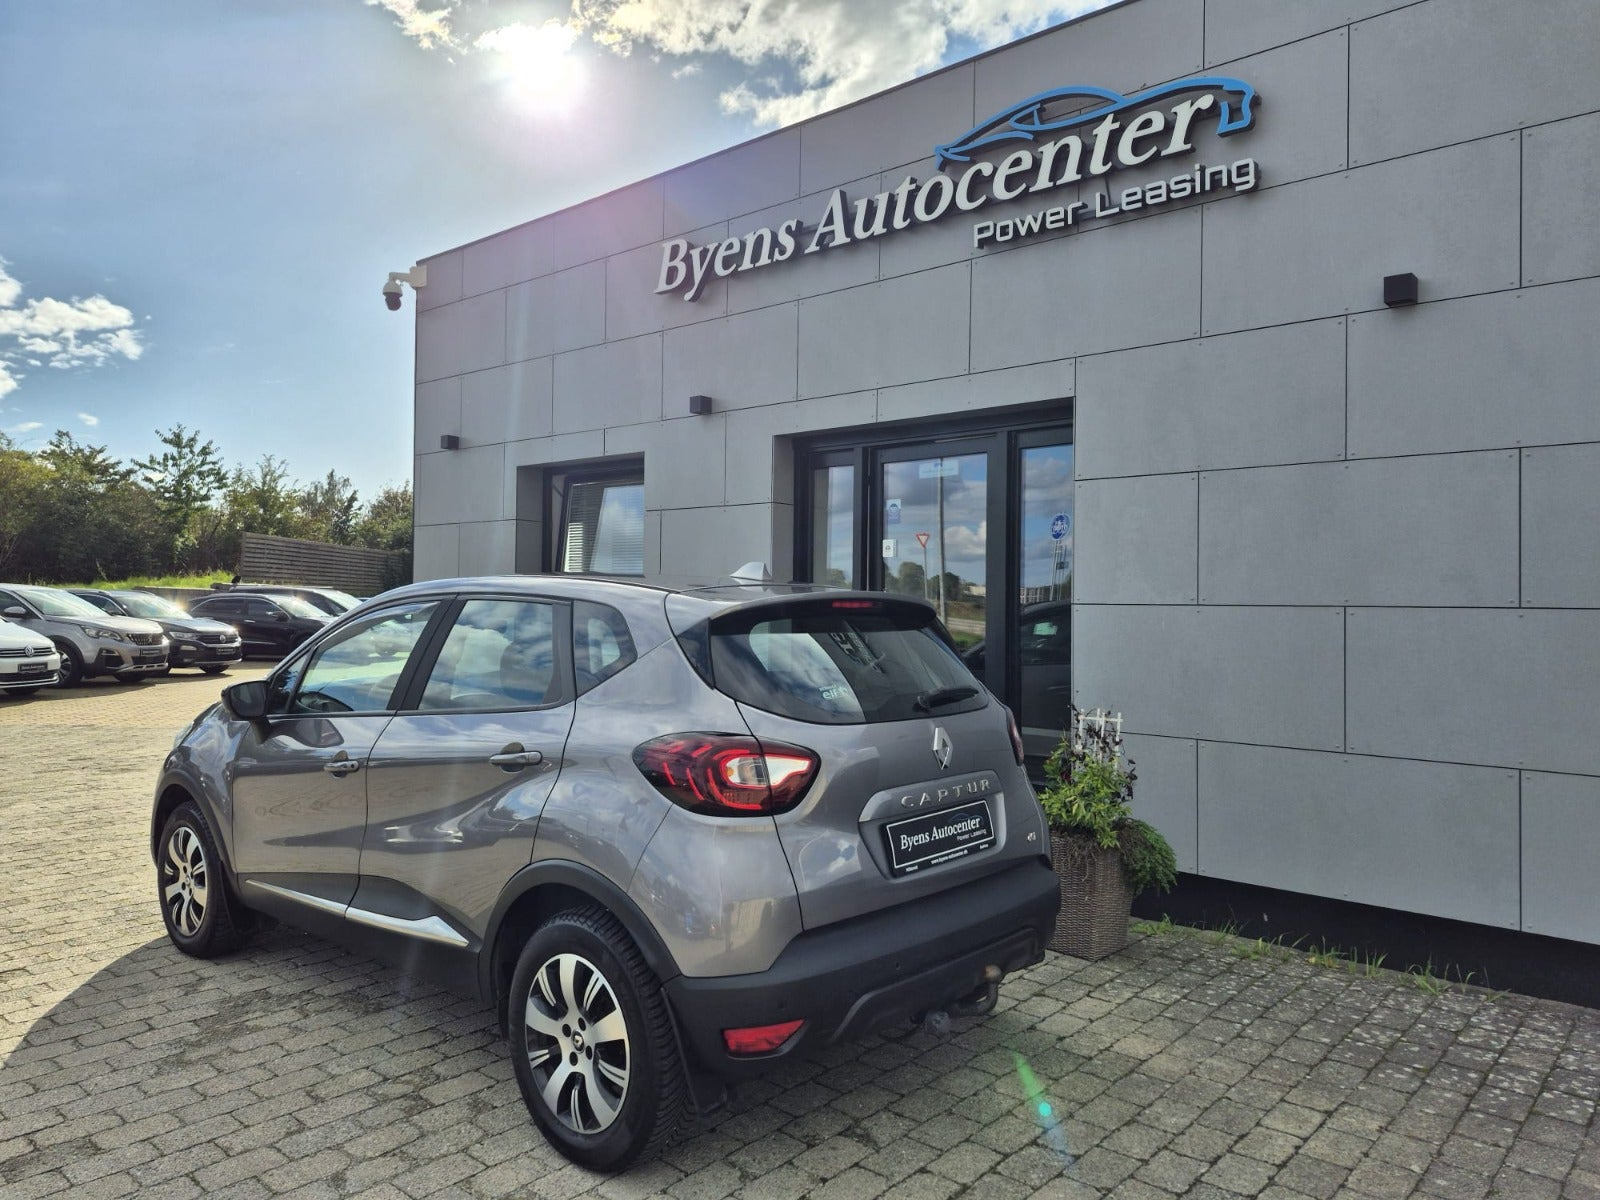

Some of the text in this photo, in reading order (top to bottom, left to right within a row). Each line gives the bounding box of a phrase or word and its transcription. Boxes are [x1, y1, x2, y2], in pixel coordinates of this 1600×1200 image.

[654, 94, 1215, 301] Byens Autocenter
[973, 157, 1256, 248] Power Leasing
[901, 779, 990, 806] CAPTUR
[900, 817, 981, 852] Byens Autocenter
